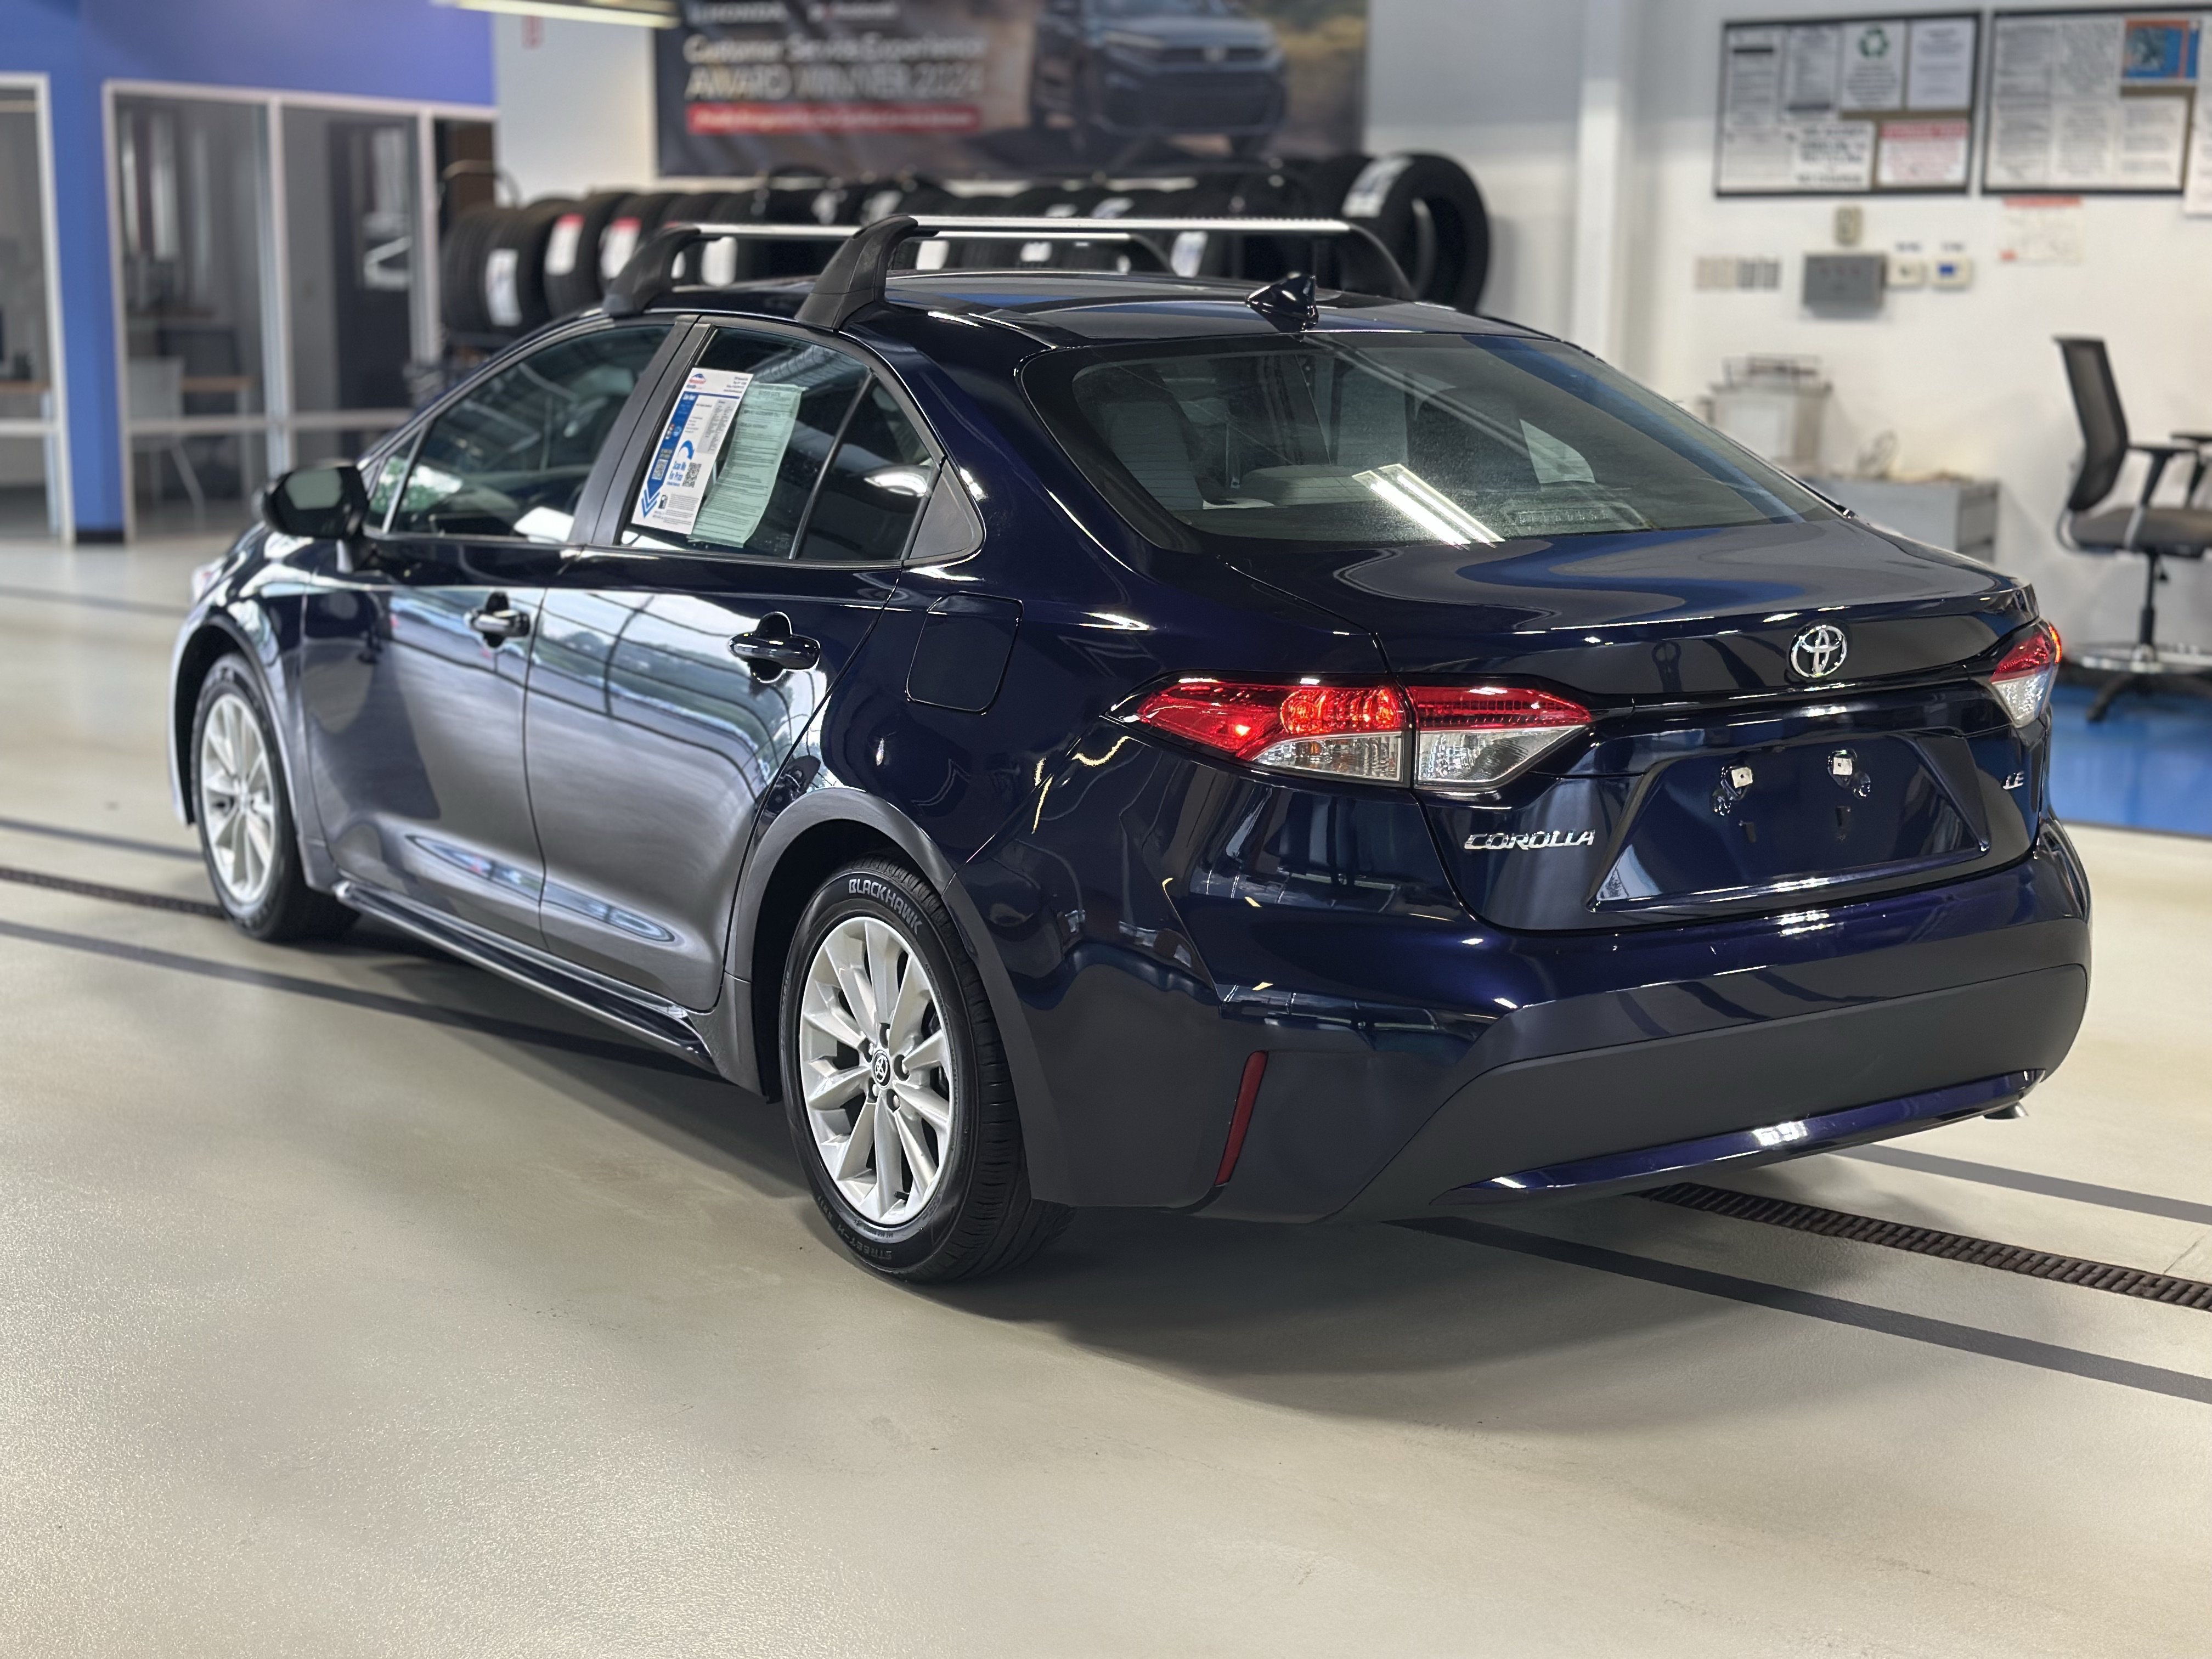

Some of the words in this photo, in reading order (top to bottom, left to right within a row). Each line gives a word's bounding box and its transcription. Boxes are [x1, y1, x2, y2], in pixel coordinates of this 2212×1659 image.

[684, 63, 793, 100] AWARD
[2003, 770, 2024, 789] LE
[1464, 830, 1595, 850] COROLLA
[849, 879, 922, 935] BLACKHAWK
